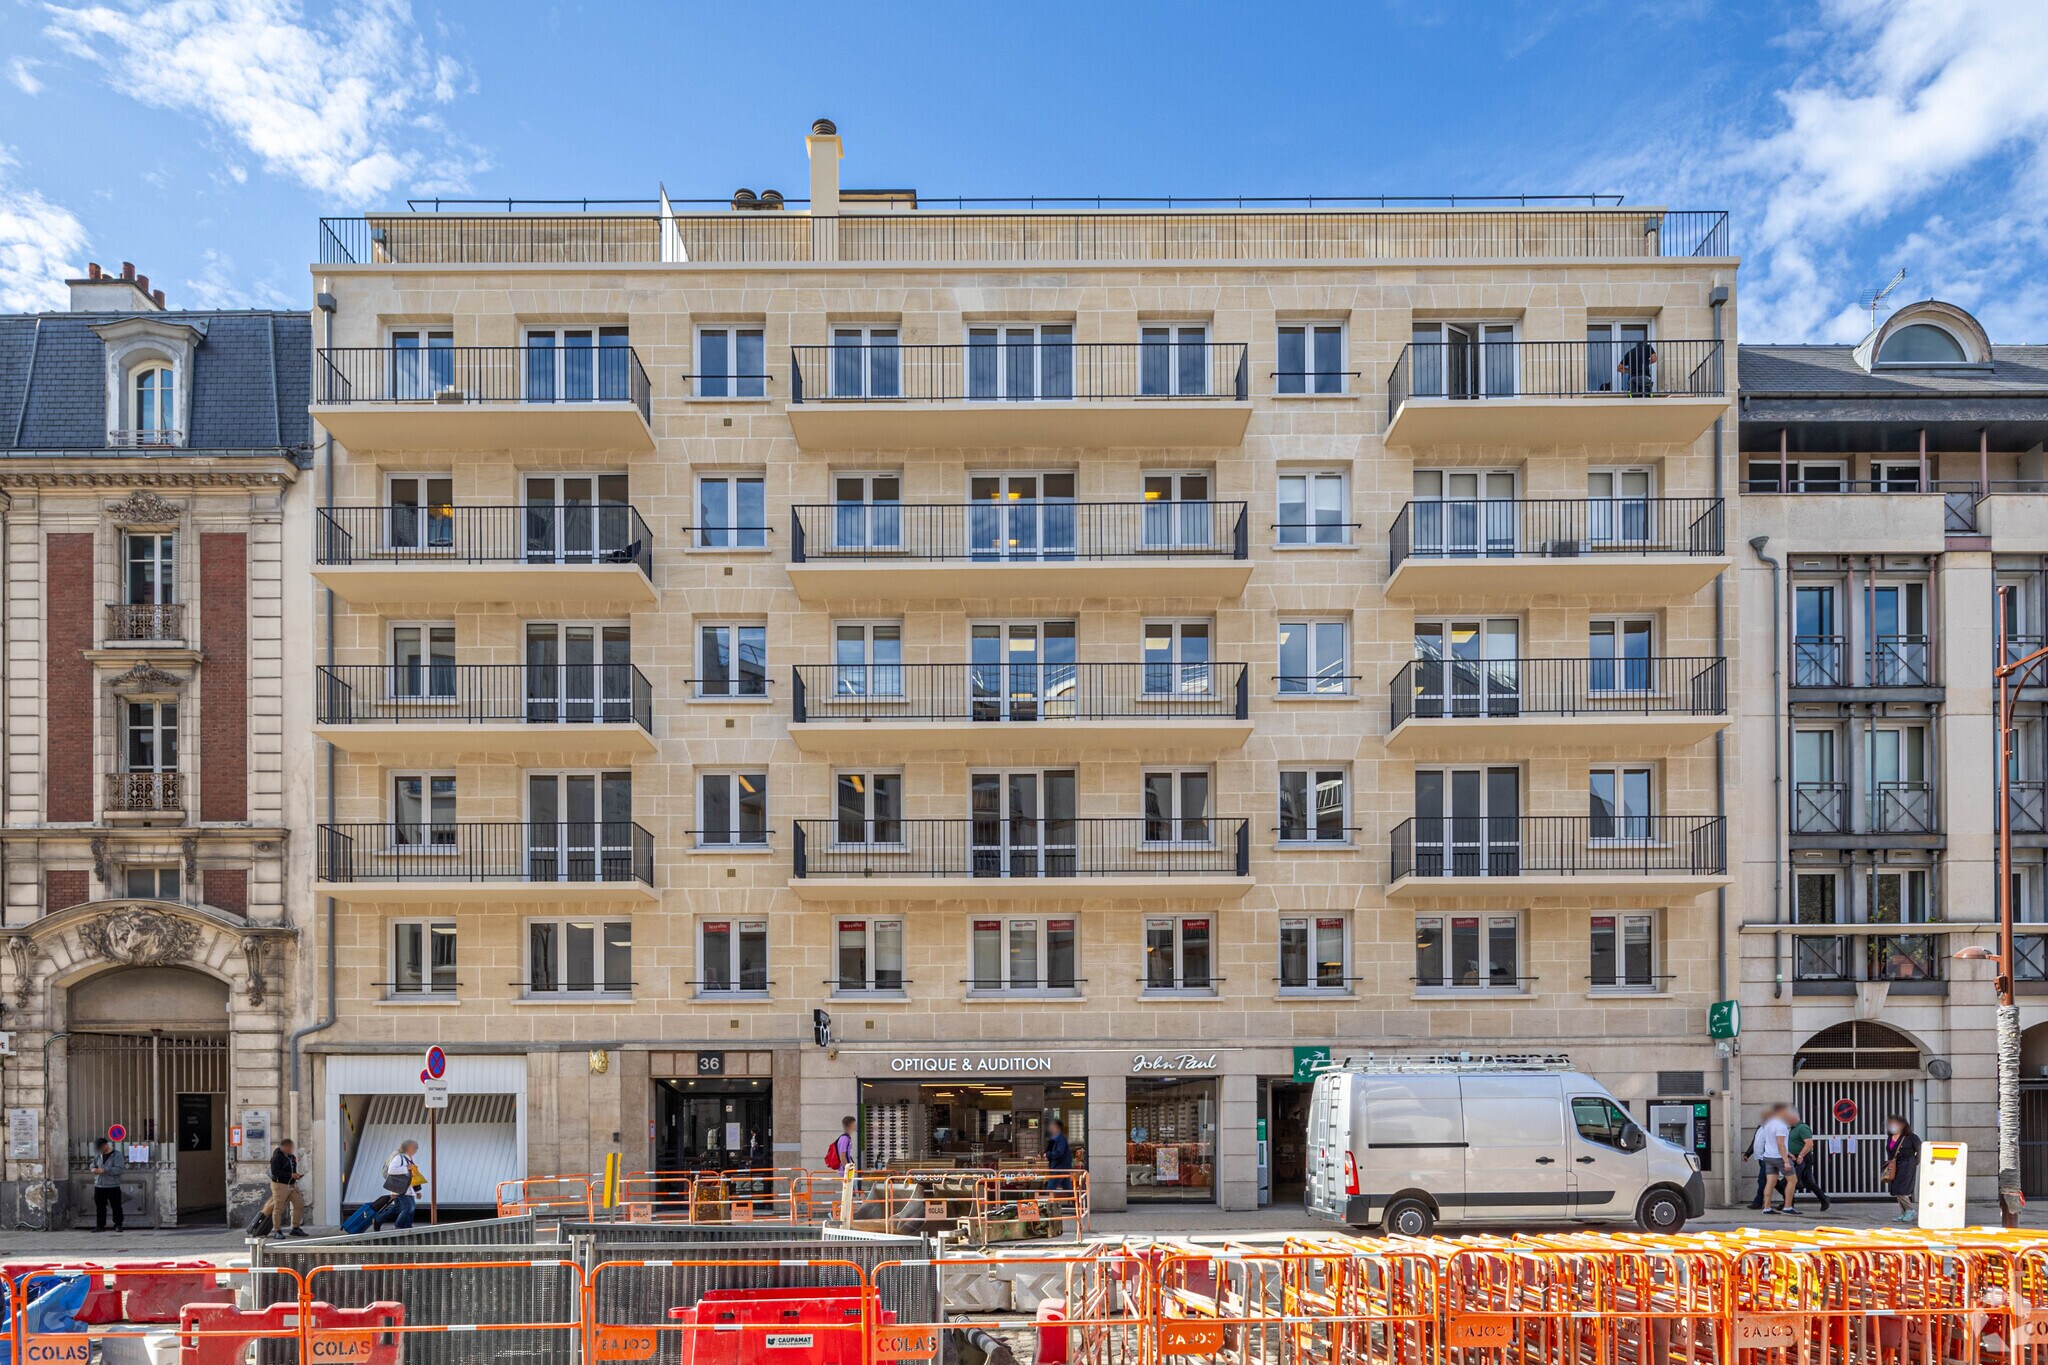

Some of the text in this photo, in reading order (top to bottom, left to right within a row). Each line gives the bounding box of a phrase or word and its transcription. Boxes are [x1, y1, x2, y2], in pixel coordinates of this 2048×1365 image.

[700, 1057, 720, 1070] 36
[891, 1057, 1051, 1071] OPTIQUE & AUDITION
[1132, 1053, 1217, 1072] John Paul
[313, 1341, 371, 1356] COLAS
[877, 1336, 937, 1352] COLAS
[28, 1345, 88, 1361] COLAS
